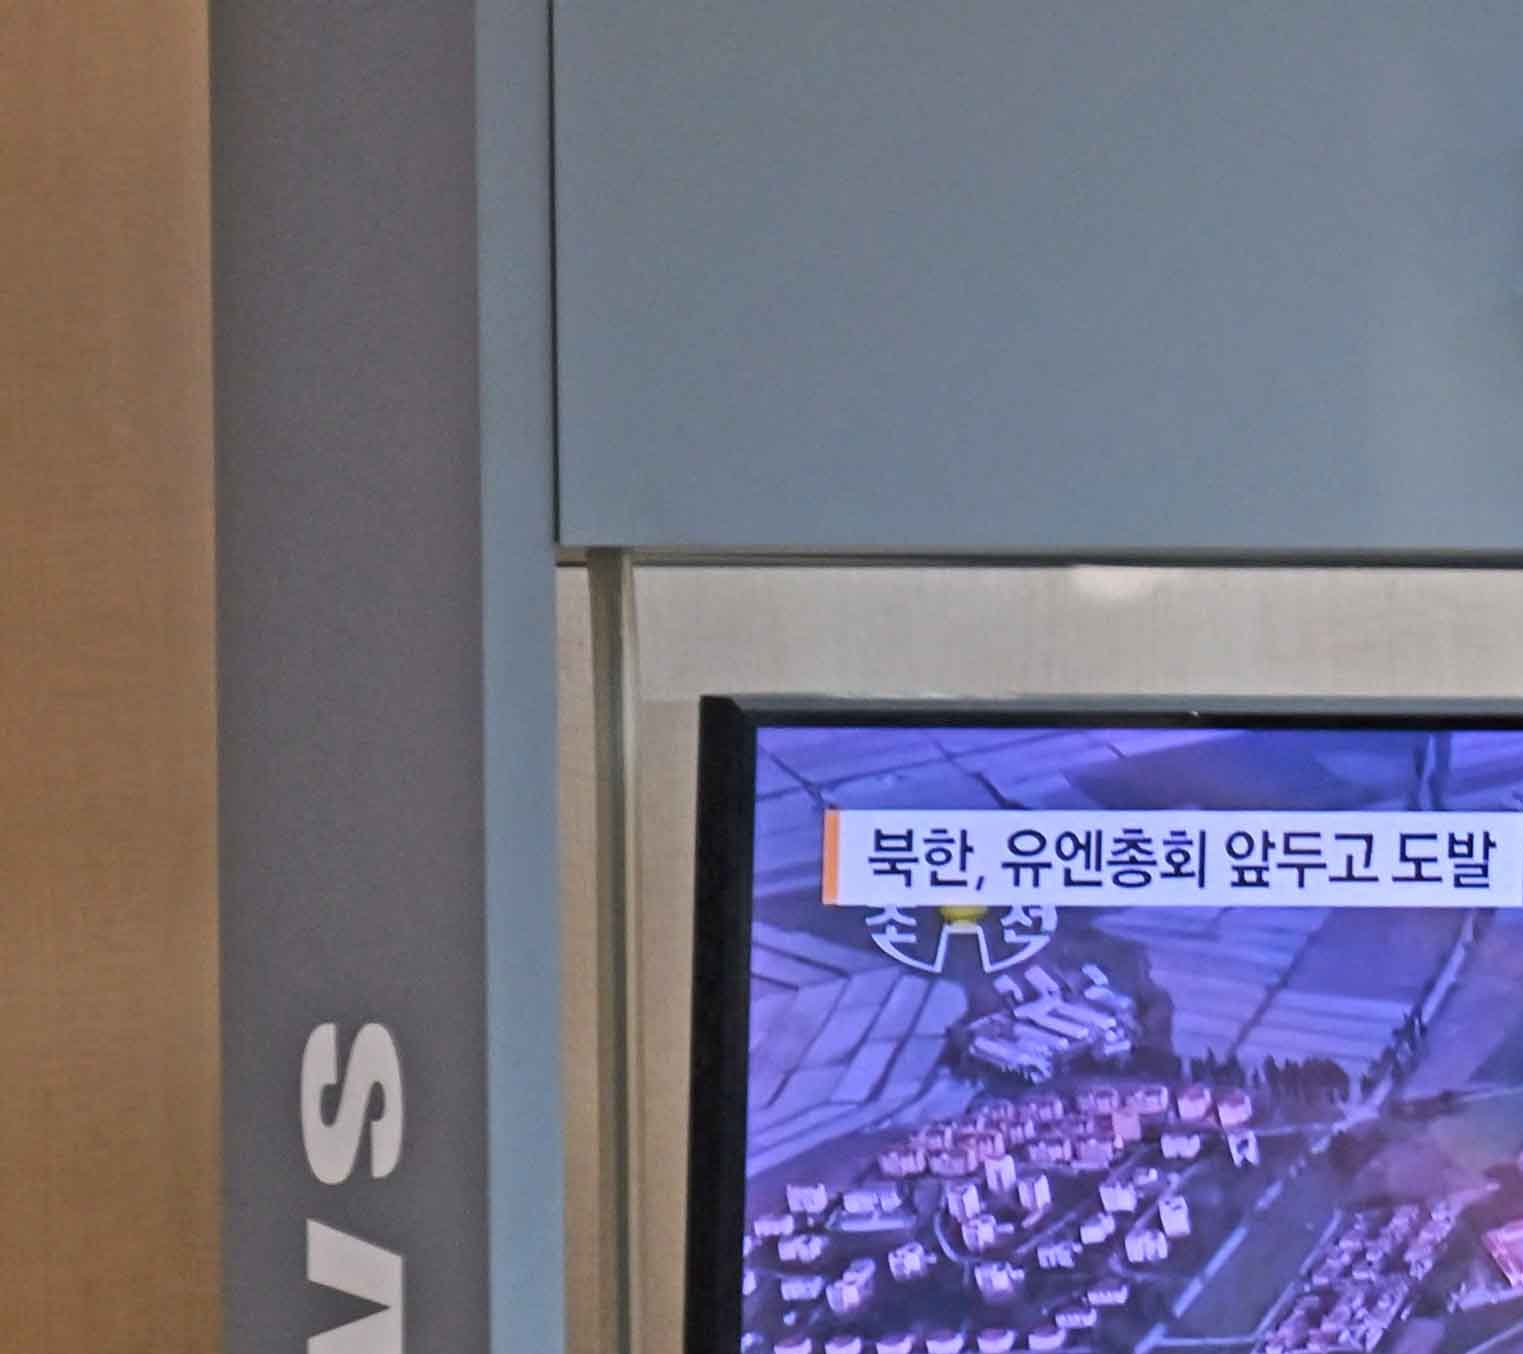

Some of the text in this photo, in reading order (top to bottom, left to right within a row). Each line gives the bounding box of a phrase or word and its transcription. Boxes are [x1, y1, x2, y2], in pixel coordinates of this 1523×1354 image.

[868, 828, 1497, 891] 북한, 유엔총회 앞두고 도발
